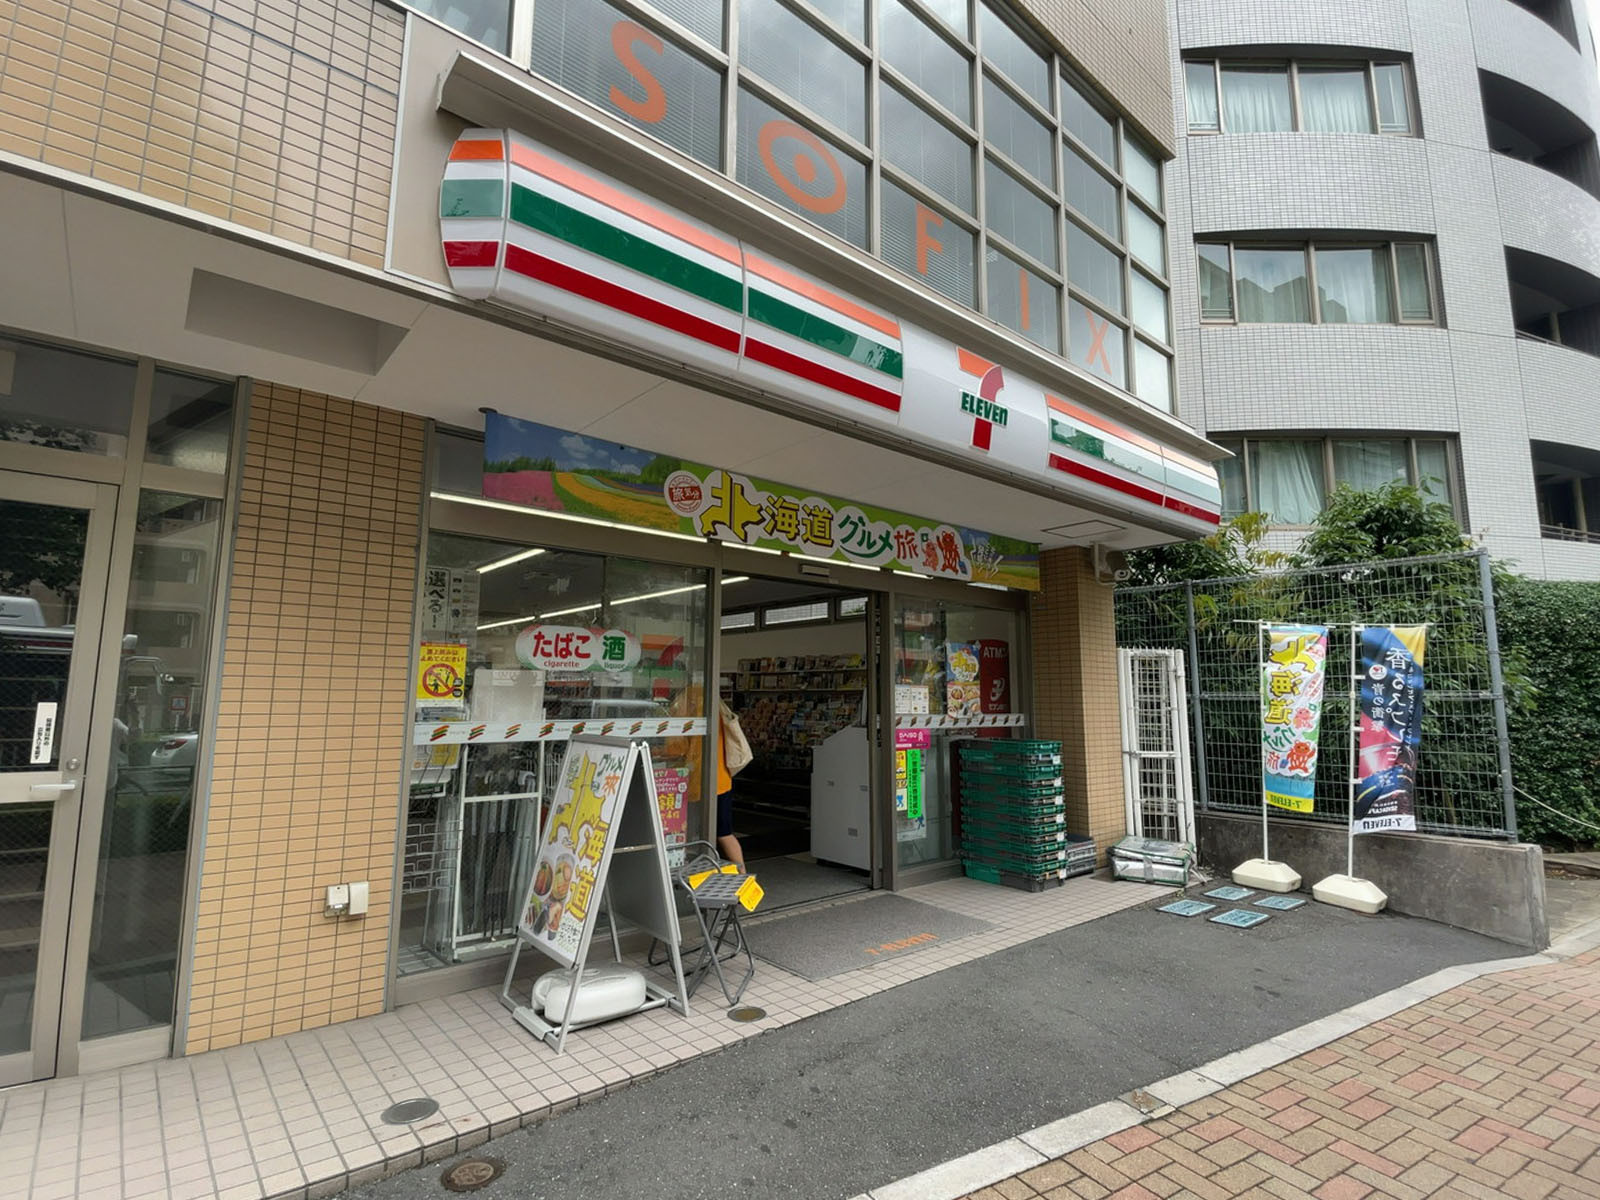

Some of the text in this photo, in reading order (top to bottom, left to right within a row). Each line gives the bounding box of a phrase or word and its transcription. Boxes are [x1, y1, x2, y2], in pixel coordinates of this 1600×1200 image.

[533, 631, 591, 659] たばこ
[602, 635, 626, 662] 酒
[543, 660, 580, 669] cigarette
[604, 662, 625, 671] liquor
